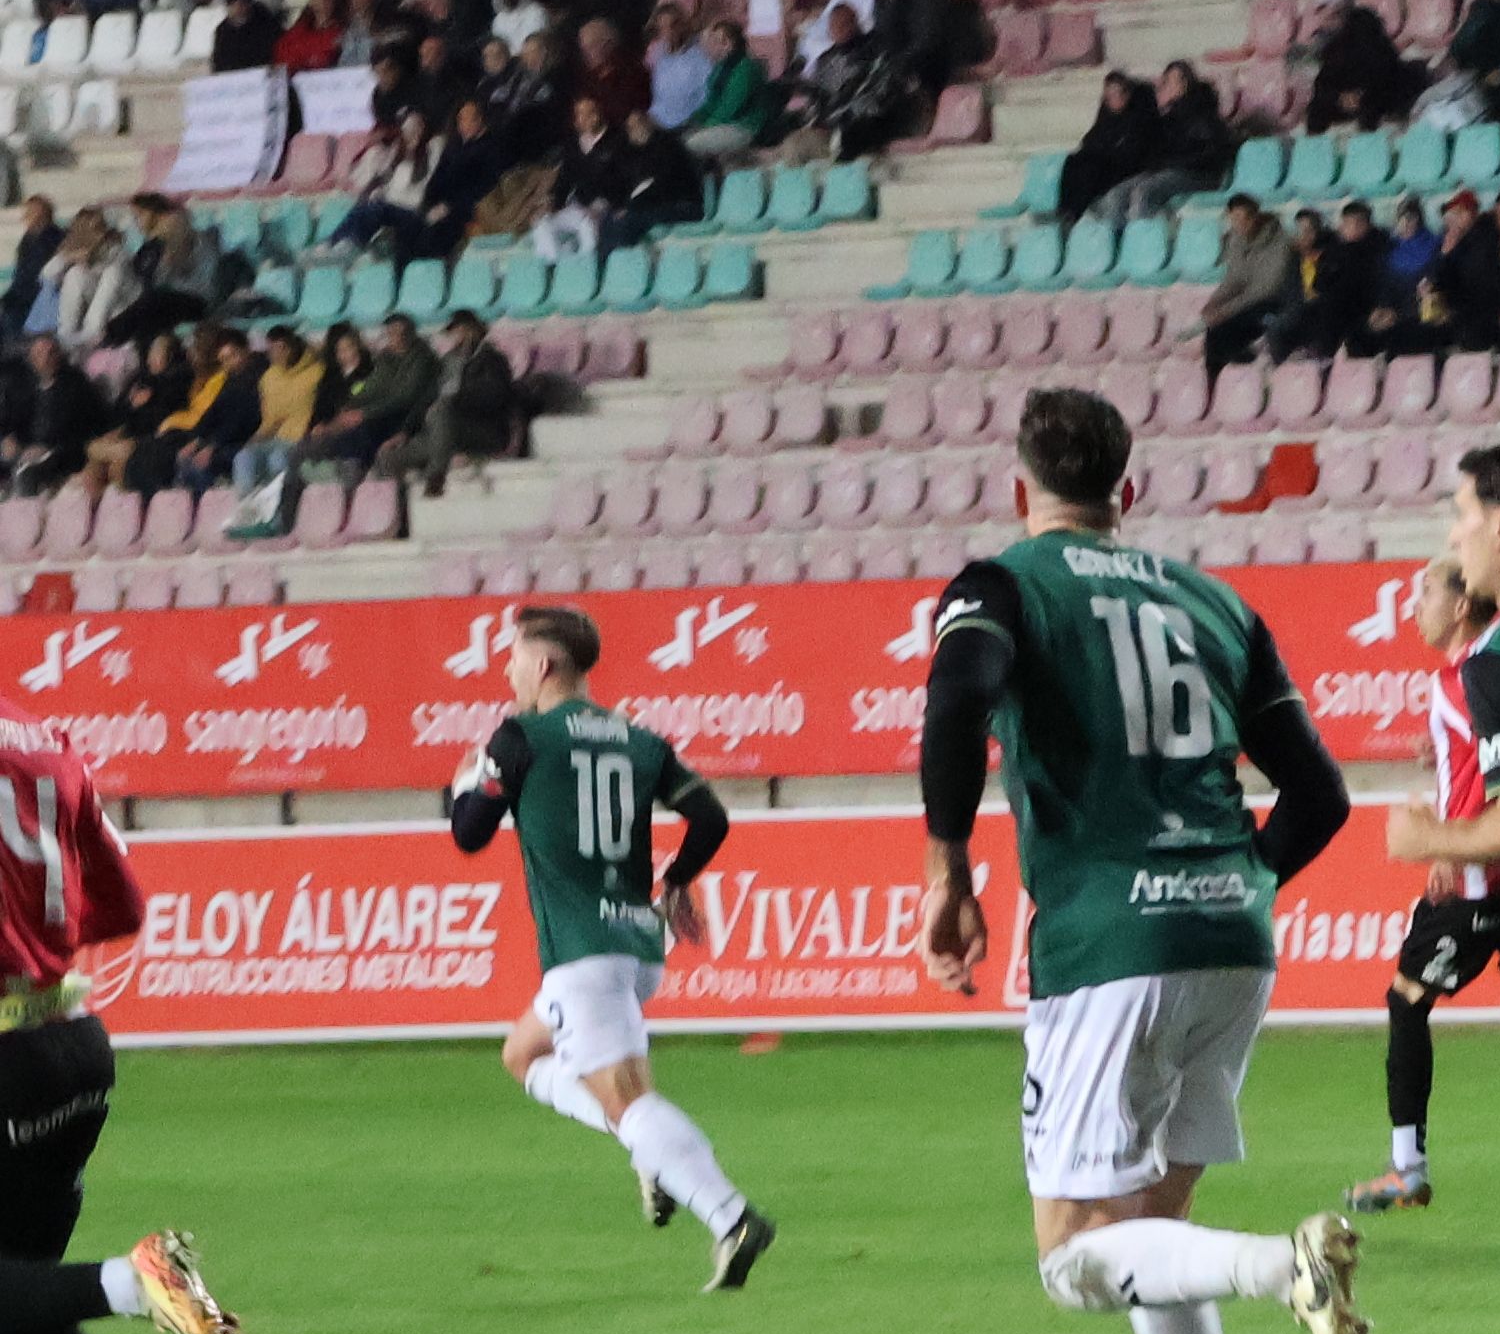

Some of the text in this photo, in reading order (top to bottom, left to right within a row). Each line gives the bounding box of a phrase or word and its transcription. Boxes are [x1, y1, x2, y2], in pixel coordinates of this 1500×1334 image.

[1090, 595, 1213, 759] 16
[1312, 666, 1432, 733] sangre
[570, 749, 636, 861] 10
[144, 873, 501, 958] ELOY ÁLVAREZ
[700, 870, 935, 960] VIVALE
